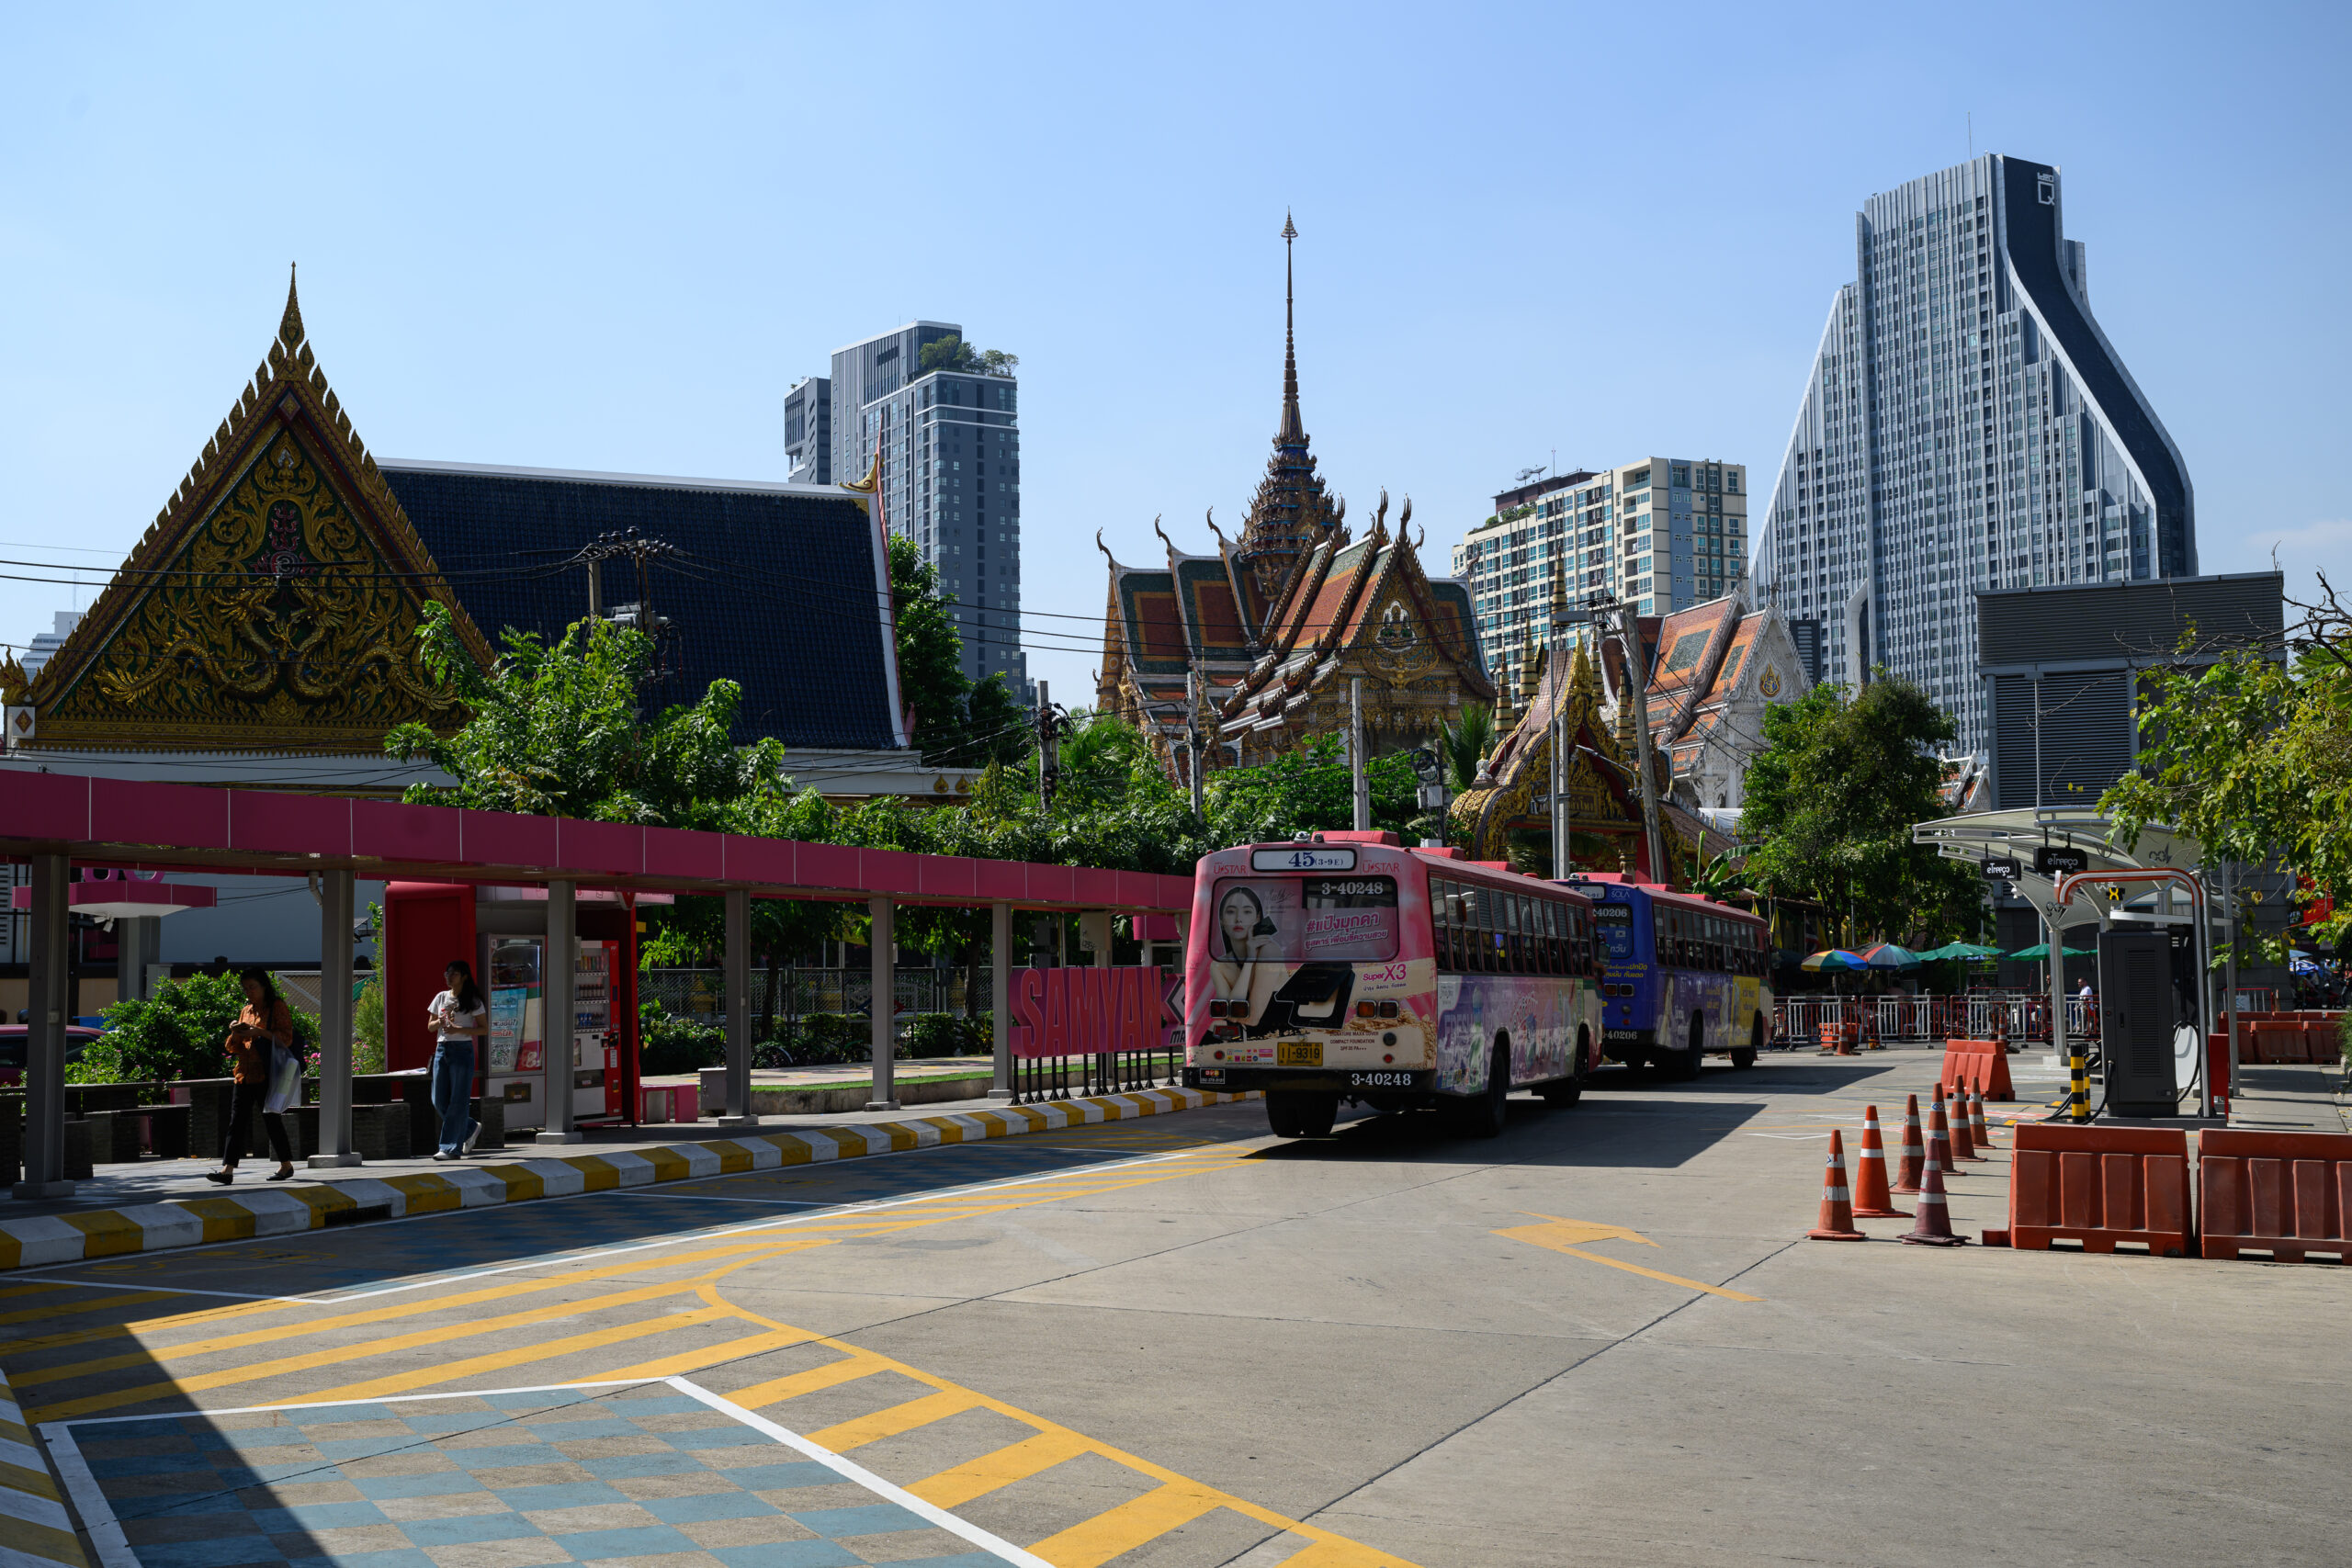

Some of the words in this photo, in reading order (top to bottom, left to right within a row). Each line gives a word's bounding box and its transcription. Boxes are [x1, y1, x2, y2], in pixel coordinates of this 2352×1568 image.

[1288, 852, 1314, 871] 45
[1321, 881, 1384, 895] 3-40248
[1363, 973, 1385, 982] Super
[1384, 964, 1408, 982] X3
[1021, 966, 1161, 1059] SAMYAN
[1351, 1073, 1411, 1086] 3-40248
